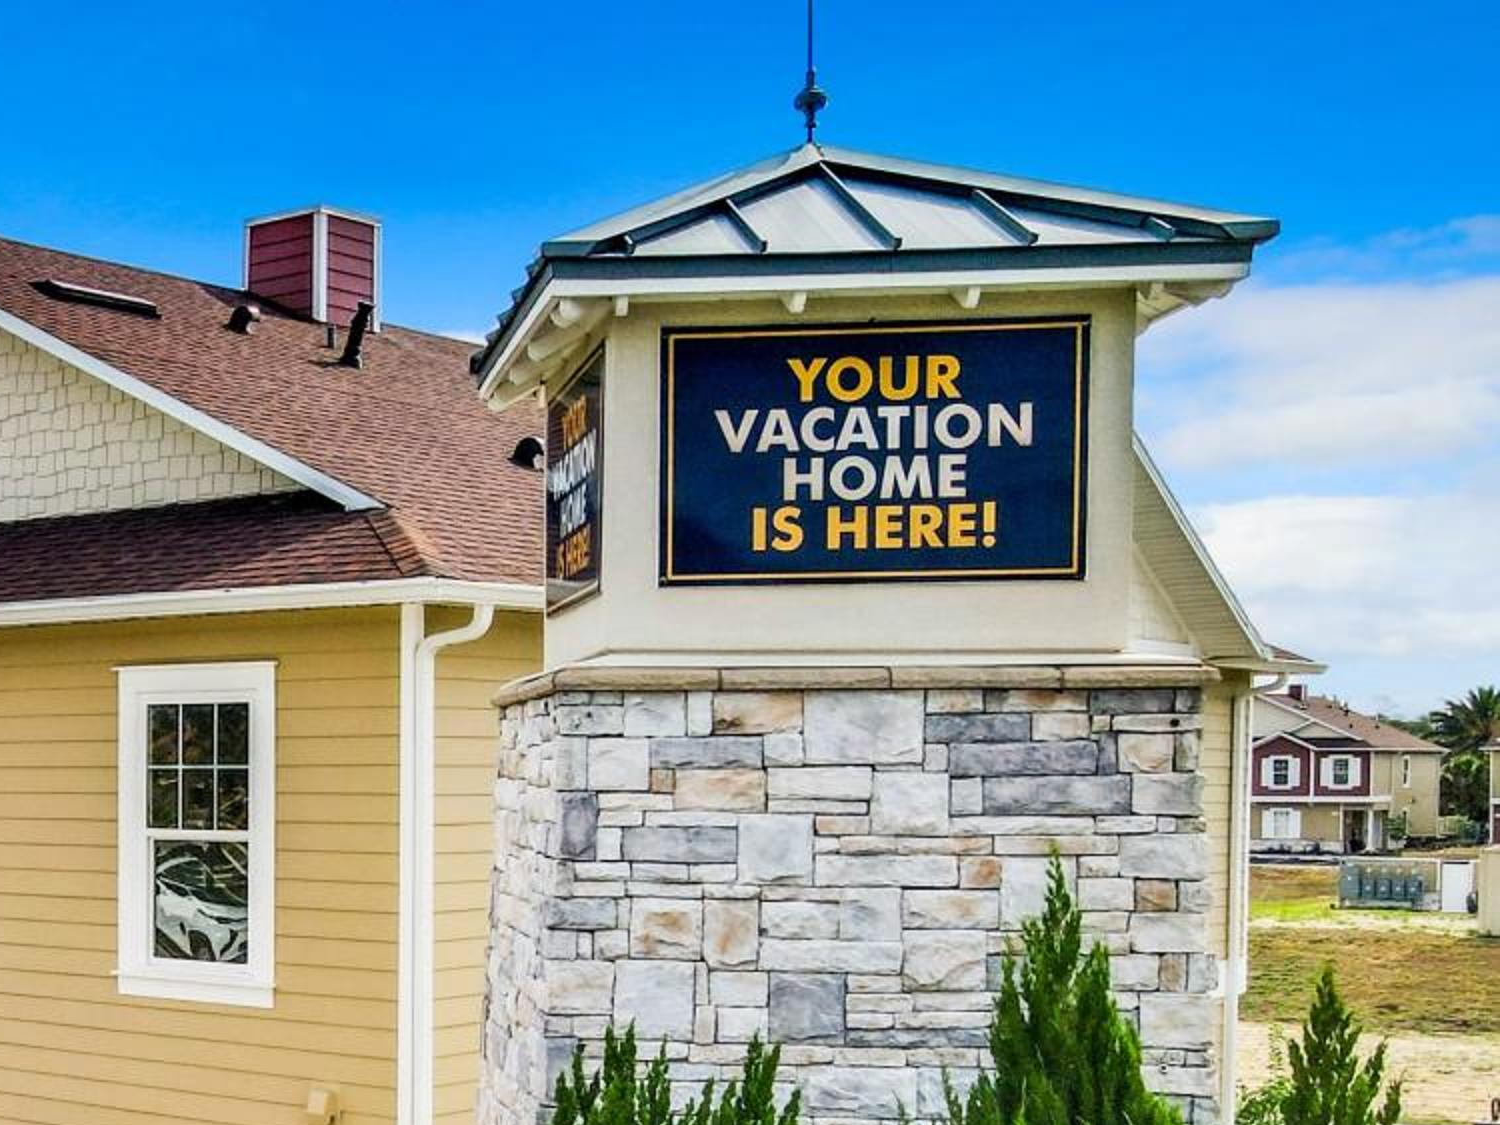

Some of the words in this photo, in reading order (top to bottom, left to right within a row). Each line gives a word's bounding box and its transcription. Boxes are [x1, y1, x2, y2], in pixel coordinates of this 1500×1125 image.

[787, 355, 962, 402] YOUR
[714, 402, 1034, 453] VACATION
[782, 453, 968, 501] HOME
[752, 506, 804, 551] IS
[826, 502, 997, 550] HERE!
